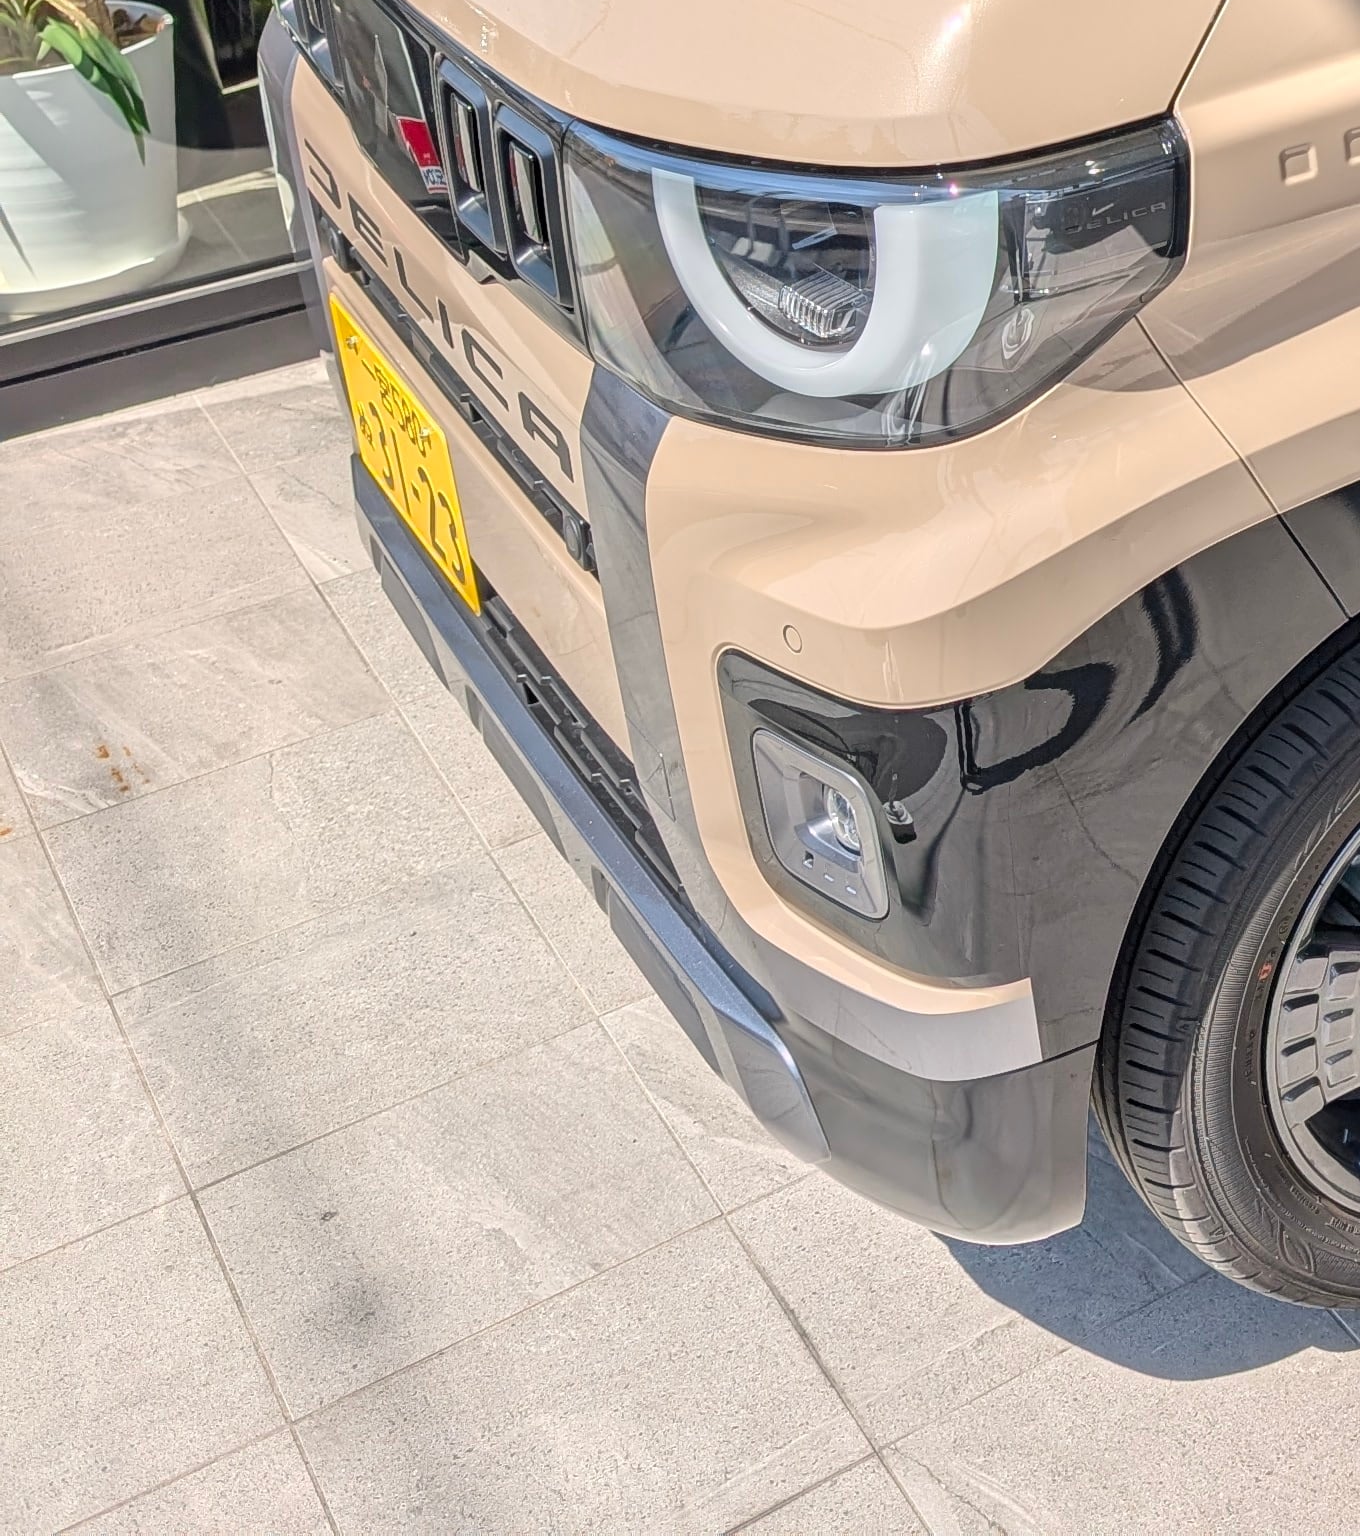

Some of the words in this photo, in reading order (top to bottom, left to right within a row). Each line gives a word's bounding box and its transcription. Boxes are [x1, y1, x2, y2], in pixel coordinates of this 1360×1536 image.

[304, 138, 574, 483] DELICA
[1064, 202, 1167, 235] DELICA
[368, 400, 467, 587] 31-23
